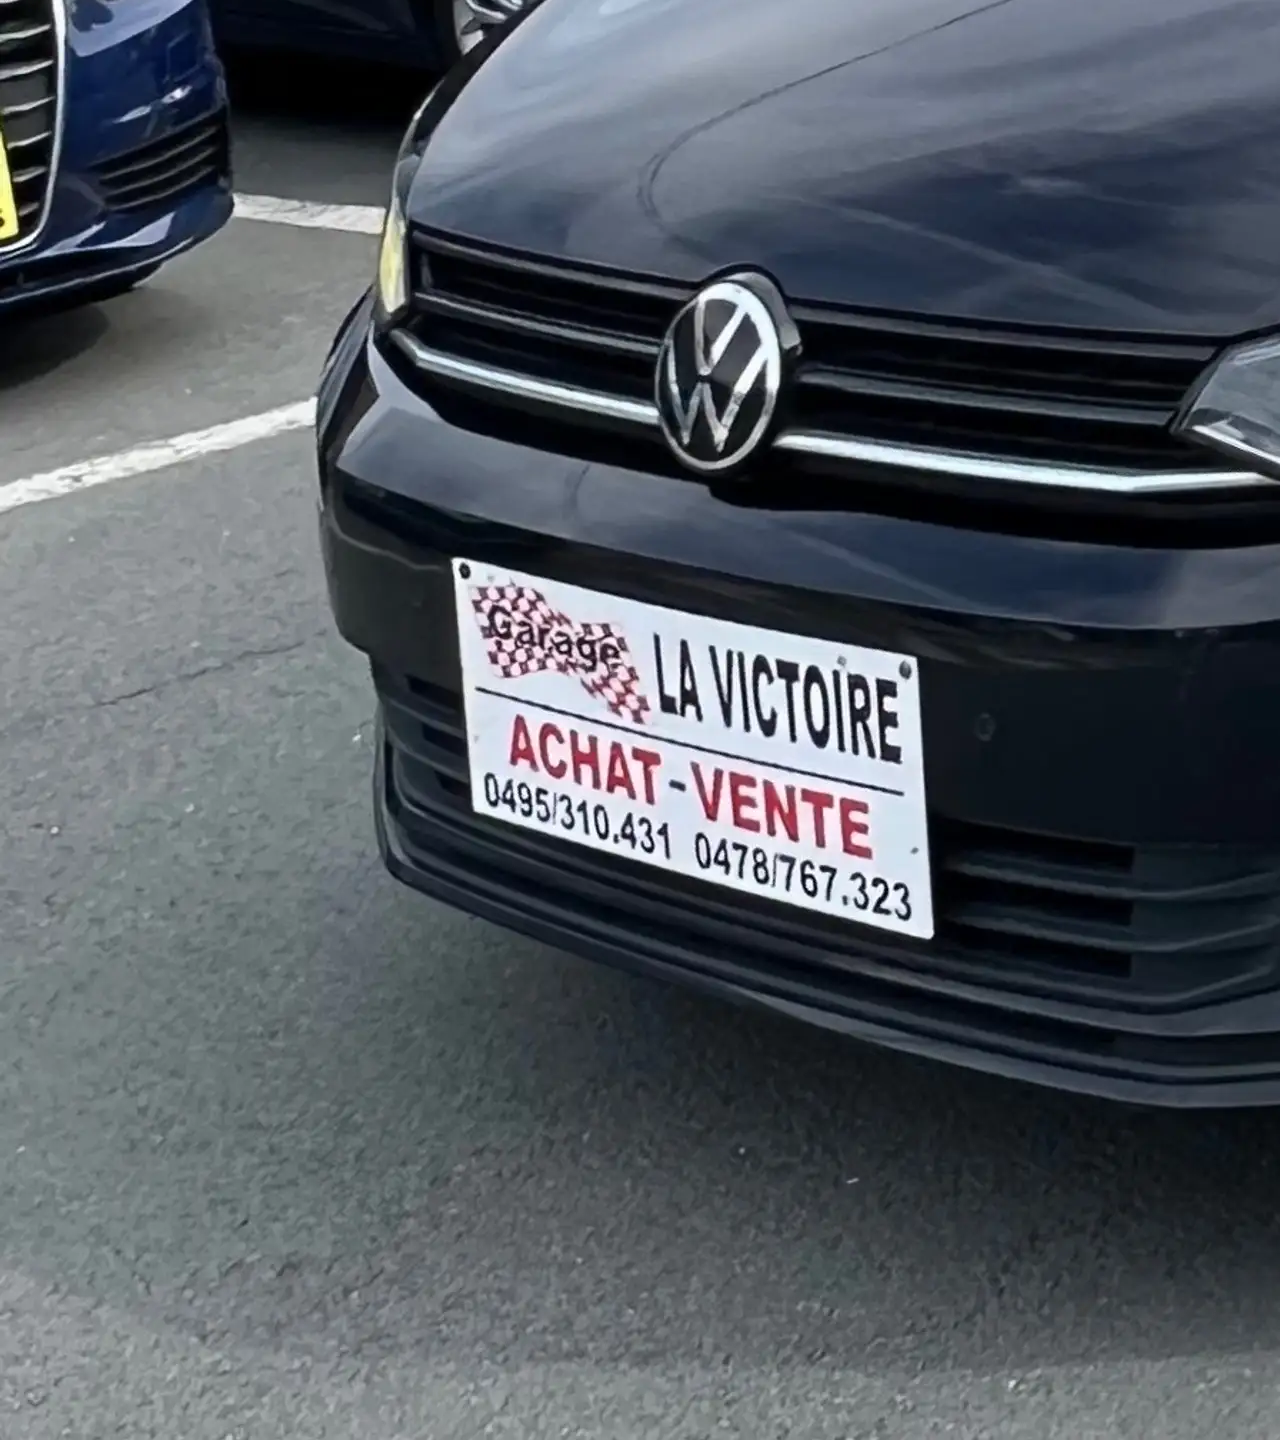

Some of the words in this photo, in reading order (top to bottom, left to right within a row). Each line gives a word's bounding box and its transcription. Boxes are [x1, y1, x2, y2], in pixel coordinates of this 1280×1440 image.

[487, 605, 621, 672] Garage
[653, 632, 703, 723] LA
[708, 644, 903, 765] VICTOIRE
[484, 771, 671, 860] 0495/310.431
[694, 832, 913, 922] 0478/767.323
